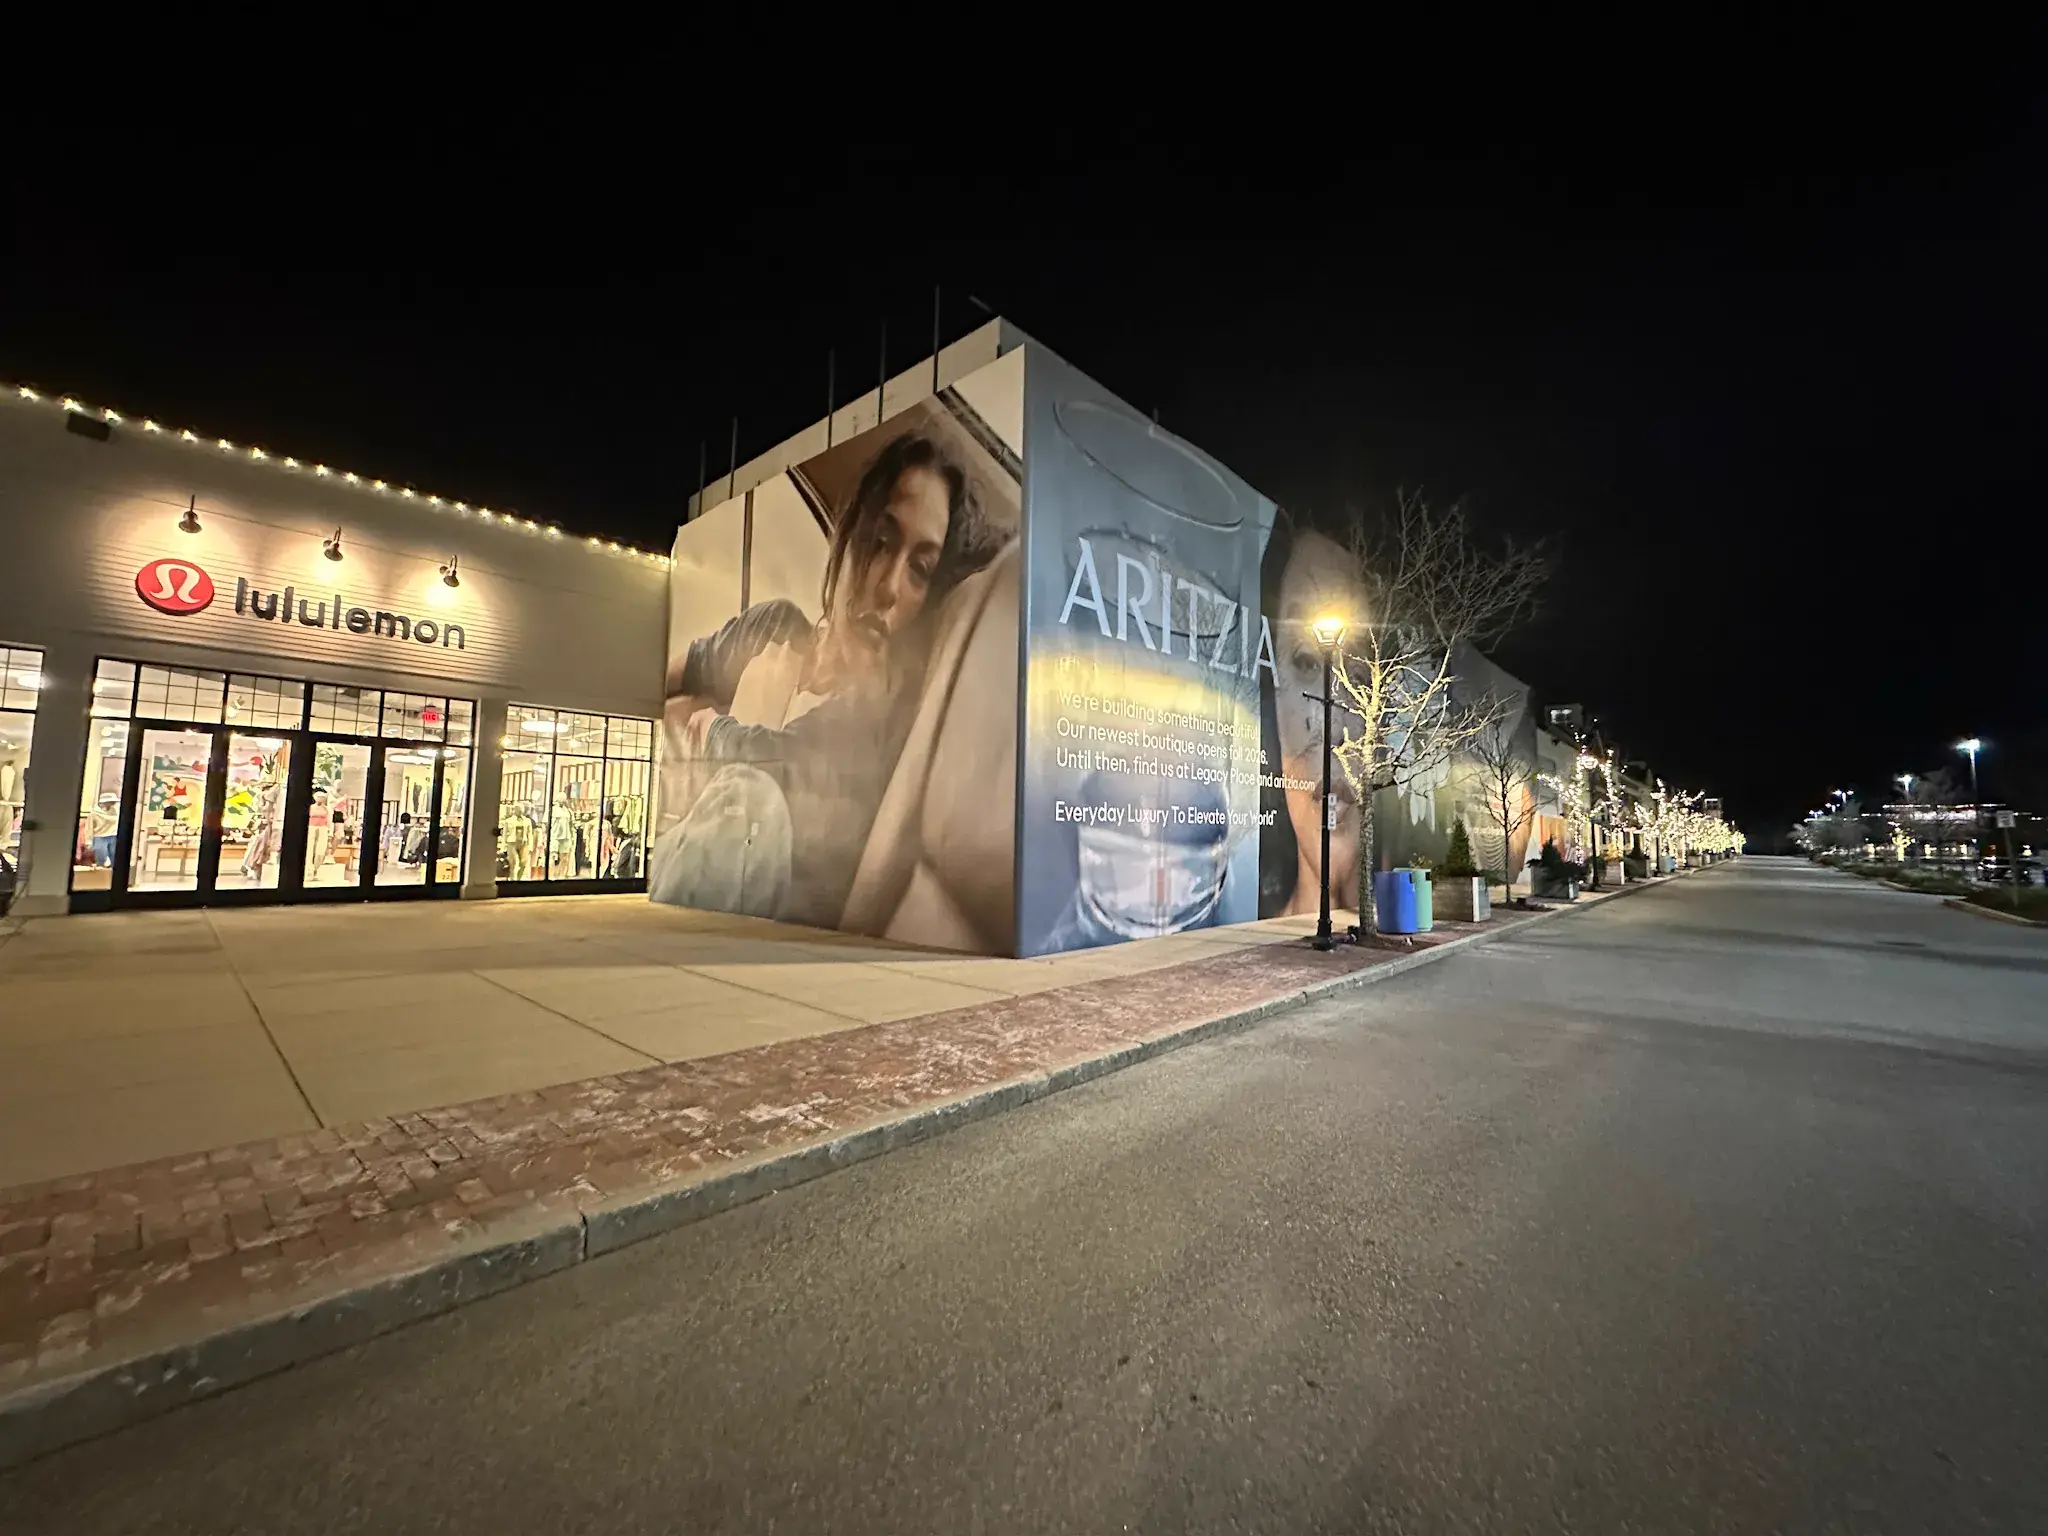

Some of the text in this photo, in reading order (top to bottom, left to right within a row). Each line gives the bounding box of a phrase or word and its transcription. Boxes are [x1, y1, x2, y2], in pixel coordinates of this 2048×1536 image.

[235, 577, 465, 649] lululemon
[1059, 537, 1279, 687] ARITZIA
[1058, 688, 1099, 711] We're
[1103, 695, 1154, 725] building
[1158, 711, 1215, 736] something
[1057, 717, 1085, 739] Our
[1089, 725, 1139, 746] newest
[1143, 730, 1194, 756] boutique
[1197, 743, 1227, 760] opens
[1229, 744, 1243, 761] fall
[1057, 747, 1315, 790] Until then, find us at Legacy Place and aritzia.com
[1055, 801, 1125, 826] Everyday
[1128, 804, 1169, 827] Luxury
[1171, 806, 1186, 824] To
[1187, 806, 1225, 825] Elevate
[1226, 808, 1248, 826] Your
